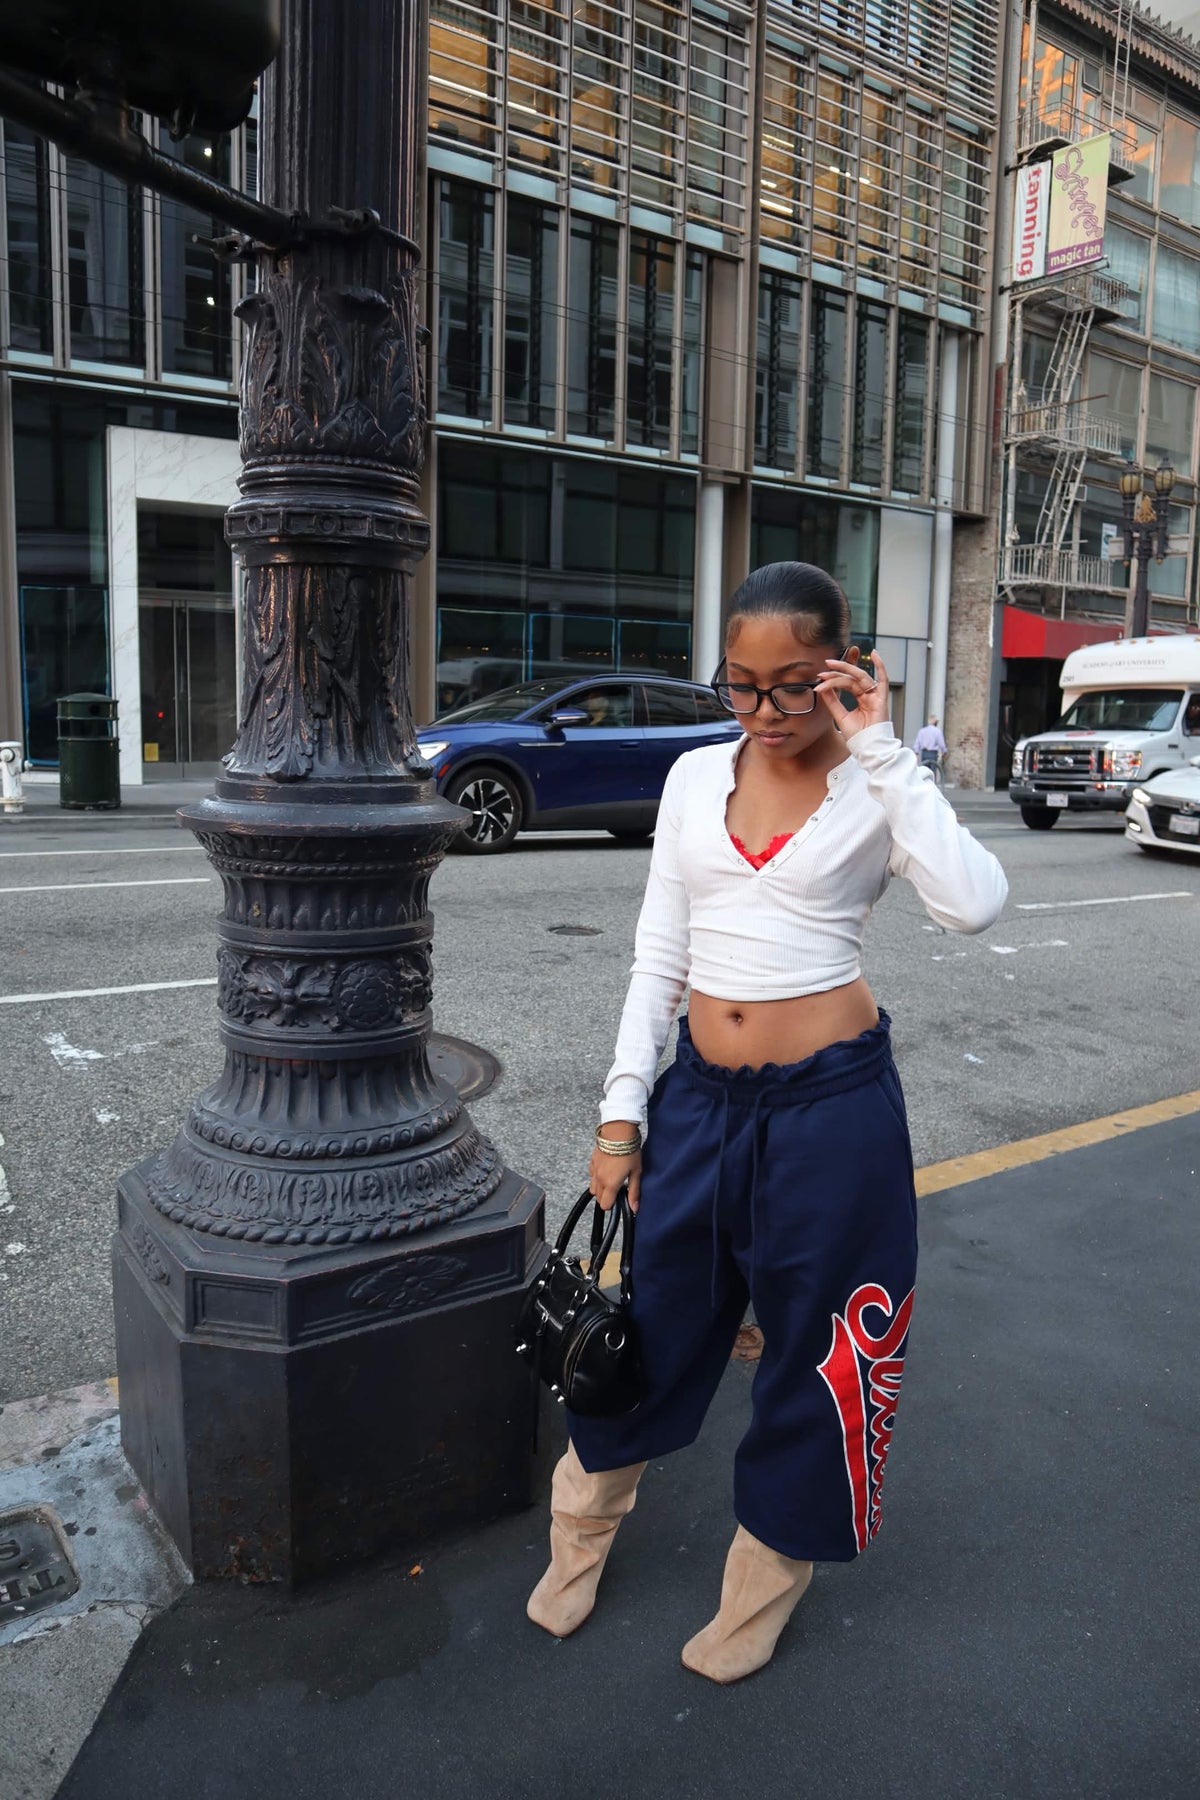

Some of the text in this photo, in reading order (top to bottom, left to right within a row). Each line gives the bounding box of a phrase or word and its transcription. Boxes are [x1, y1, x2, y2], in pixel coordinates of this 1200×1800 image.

[1017, 167, 1042, 276] tanning
[1050, 243, 1101, 267] magic tan
[1127, 658, 1166, 666] UNIVERSITY
